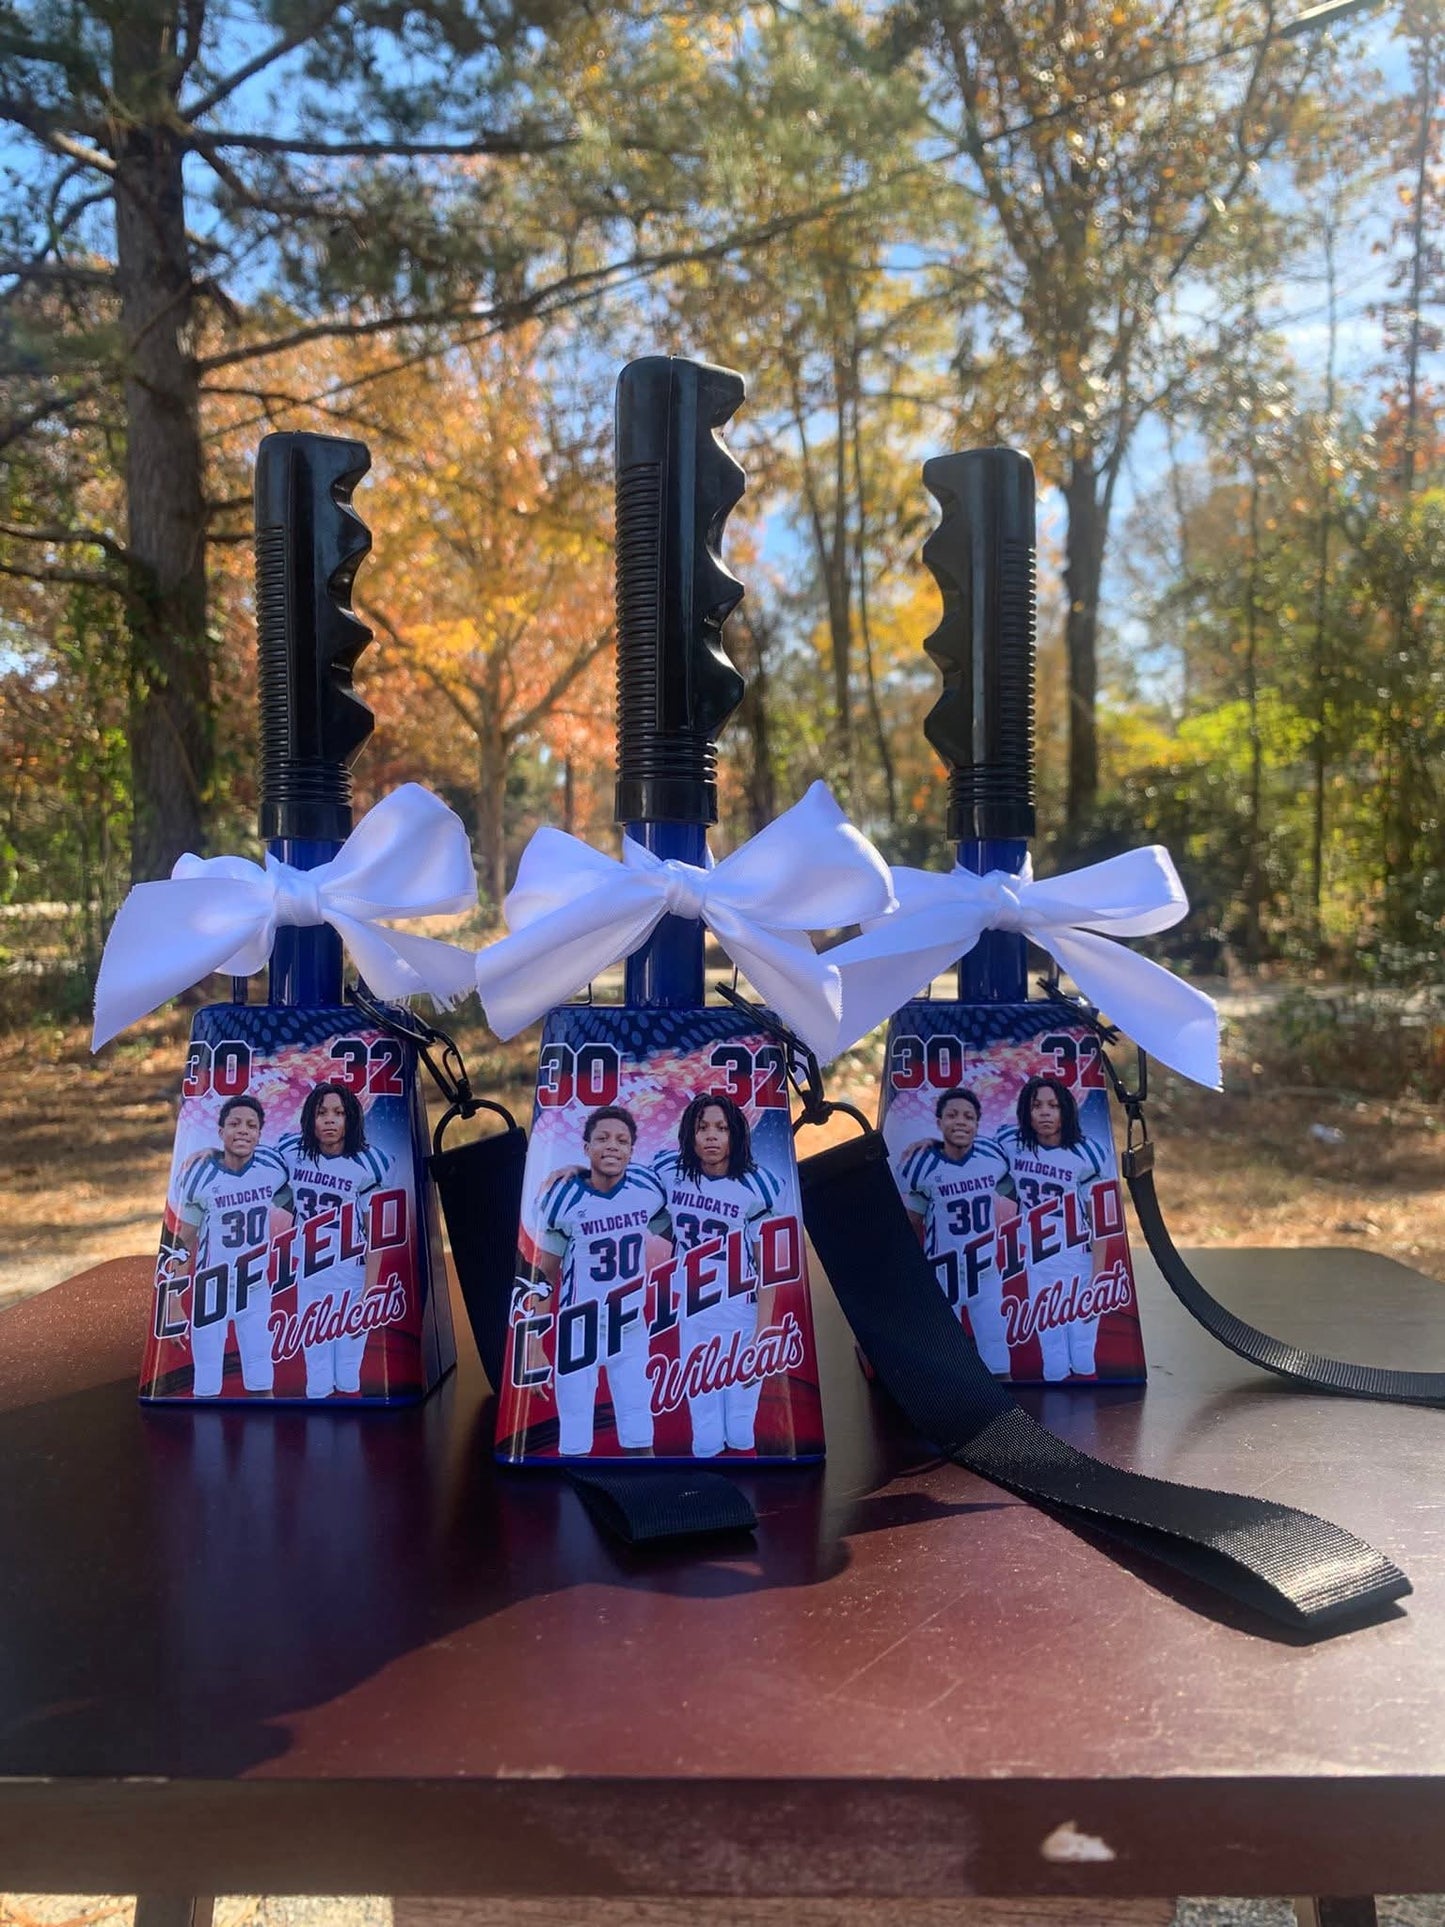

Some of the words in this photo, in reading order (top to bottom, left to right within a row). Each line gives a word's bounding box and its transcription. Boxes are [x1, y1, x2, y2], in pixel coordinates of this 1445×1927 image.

[183, 1040, 252, 1098] 30
[329, 1039, 403, 1097] 32
[538, 1043, 621, 1109] 30
[710, 1043, 789, 1110] 32
[891, 1035, 964, 1091] 30
[1042, 1034, 1107, 1090] 32
[215, 1186, 273, 1209] WILDCATS
[294, 1169, 353, 1192] WILDCATS
[939, 1176, 995, 1197] WILDCATS
[1015, 1159, 1073, 1182] WILDCATS
[222, 1207, 268, 1248] 30
[582, 1210, 648, 1236] WILDCATS
[672, 1191, 740, 1218] WILDCATS
[948, 1196, 991, 1235] 30
[155, 1189, 408, 1339] COFIELD
[590, 1233, 641, 1282] 30
[268, 1273, 406, 1363] Wildcats
[512, 1216, 801, 1388] COFIELD
[1001, 1260, 1132, 1347] Wildcats
[646, 1313, 803, 1416] Wildcats
